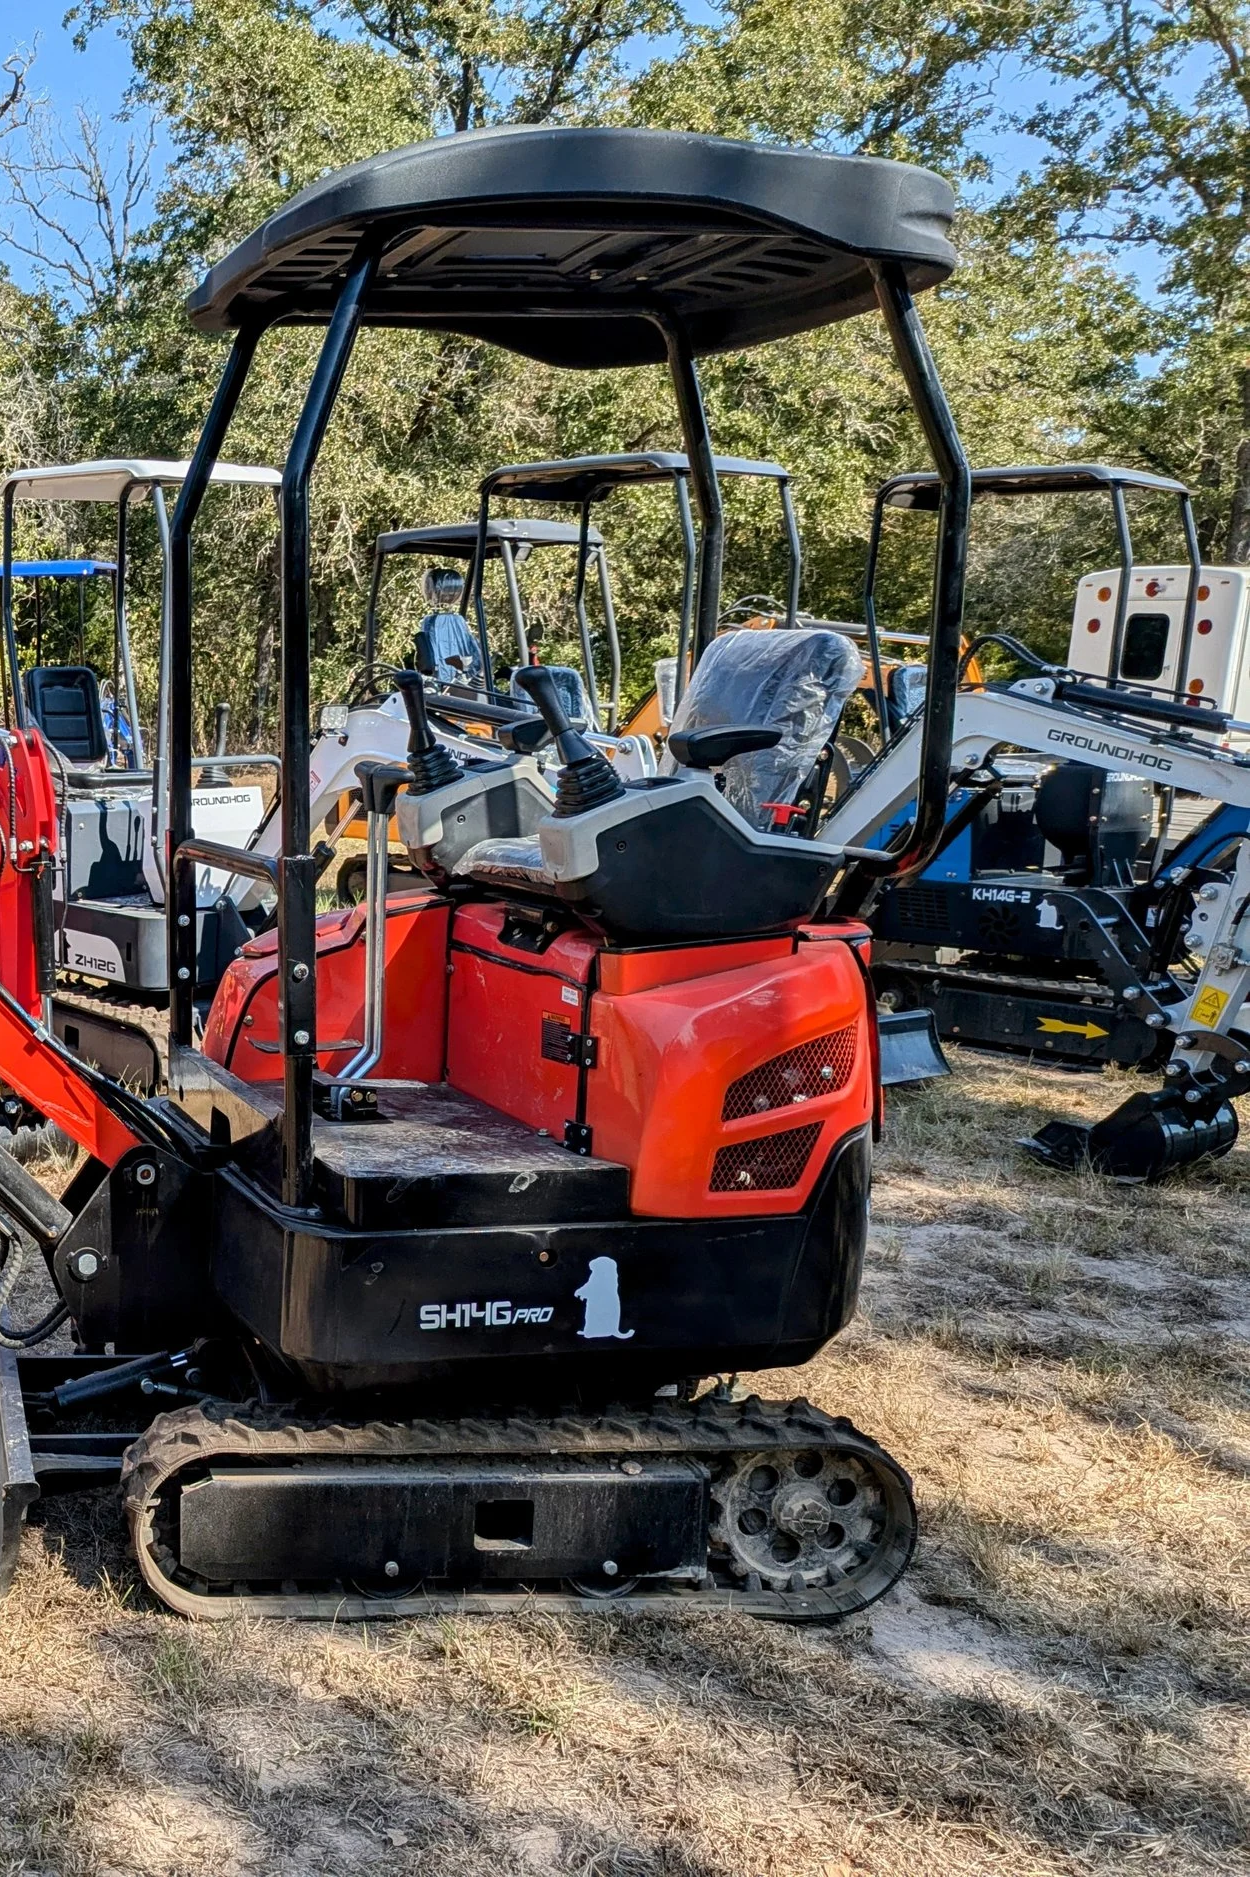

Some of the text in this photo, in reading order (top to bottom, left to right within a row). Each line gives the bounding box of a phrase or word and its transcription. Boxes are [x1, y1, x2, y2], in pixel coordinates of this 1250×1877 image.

[1047, 728, 1173, 772] GROUNDHOG
[972, 887, 1031, 904] KH14G-2
[74, 953, 116, 974] ZH12G
[419, 1300, 554, 1330] SH14G PRO
